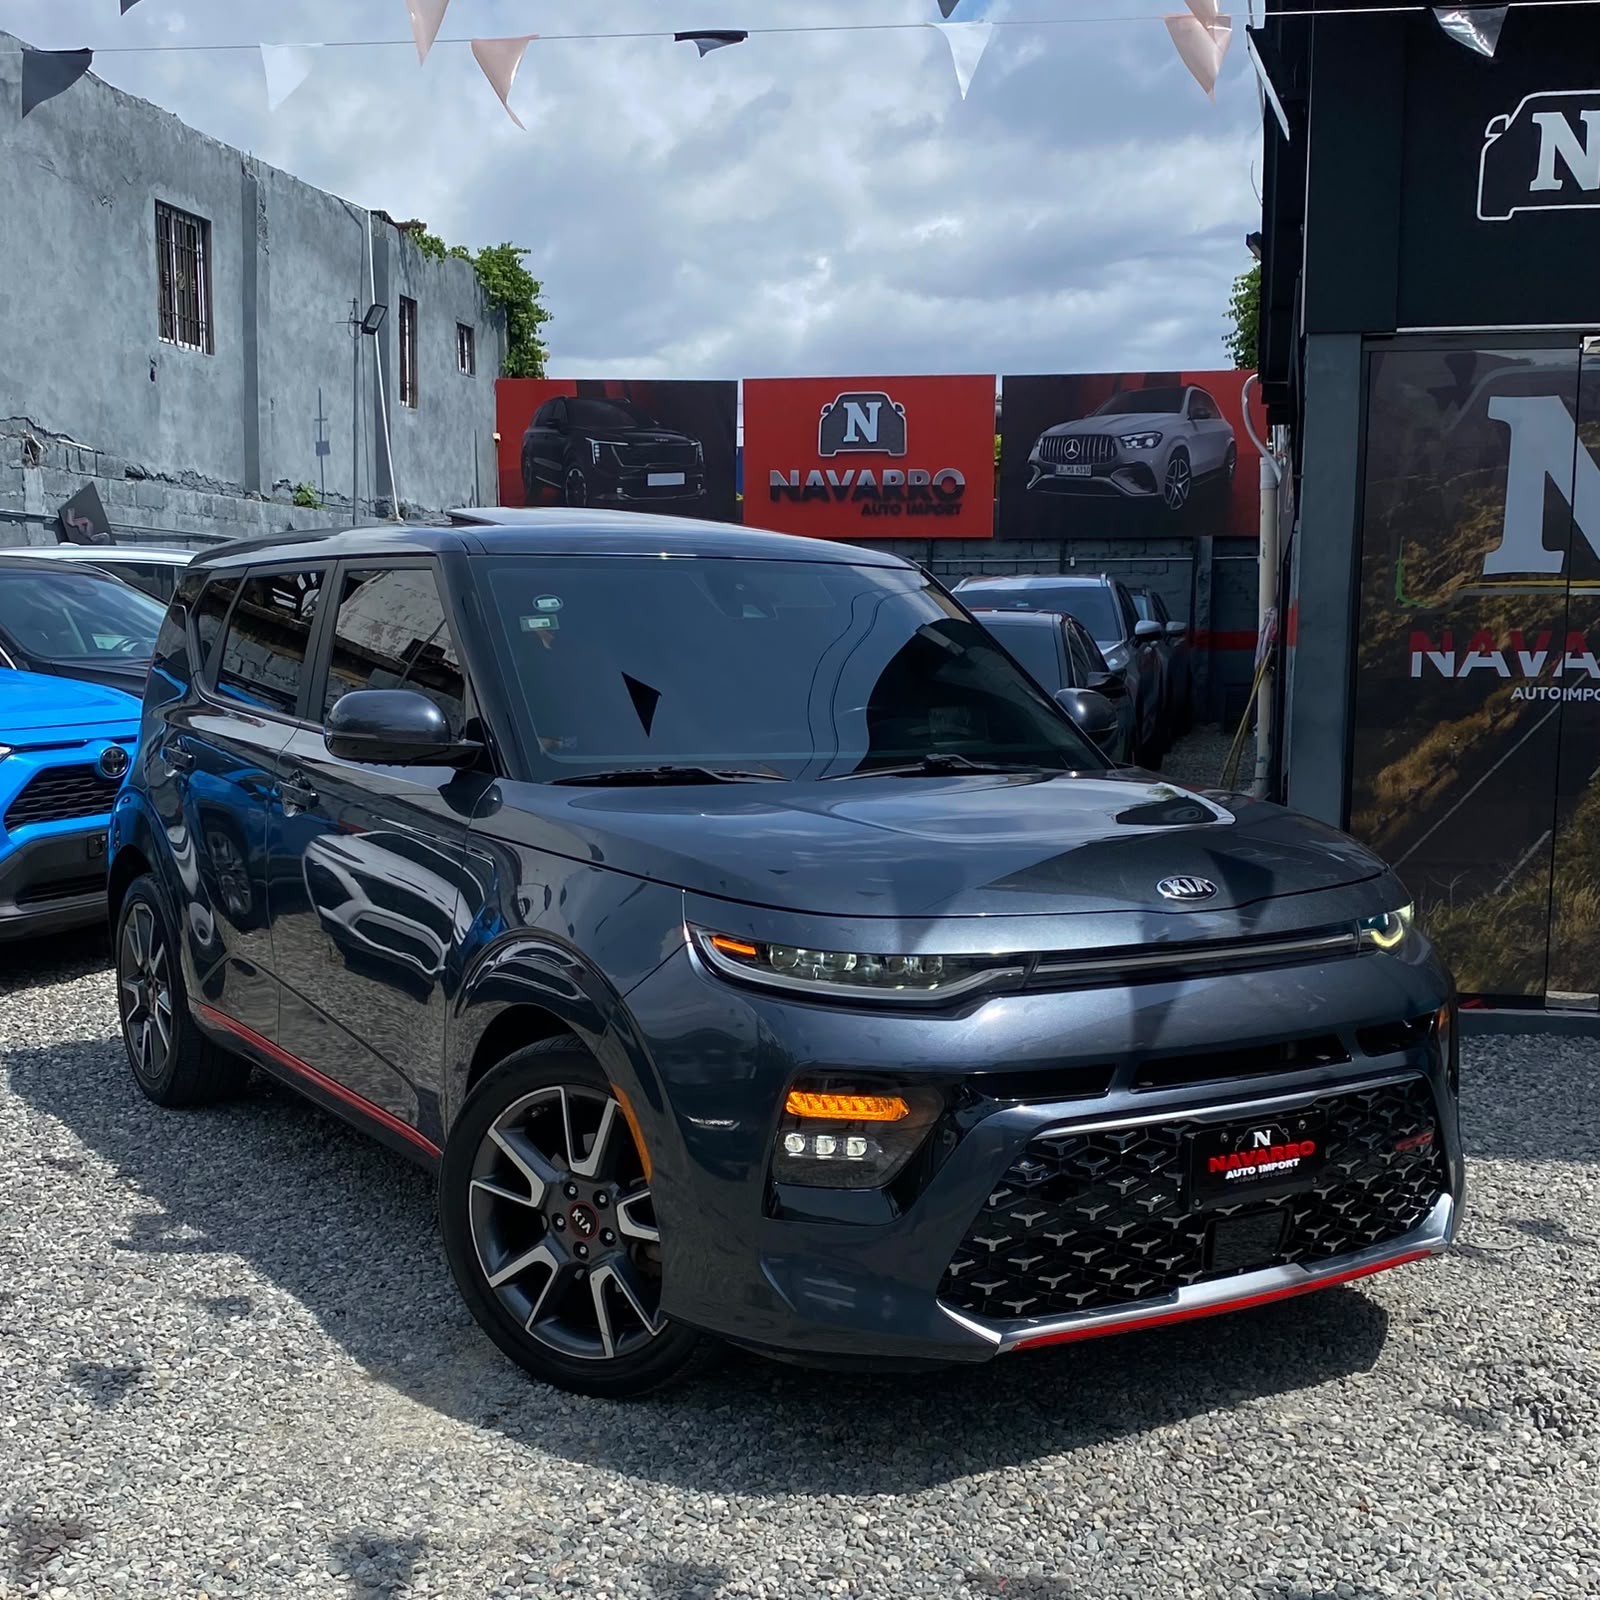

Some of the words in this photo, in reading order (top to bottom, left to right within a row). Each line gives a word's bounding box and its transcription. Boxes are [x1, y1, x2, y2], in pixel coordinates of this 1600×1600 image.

[1529, 109, 1600, 191] N
[843, 401, 882, 443] N
[769, 467, 966, 503] NAVARRO
[1483, 395, 1600, 576] N
[861, 503, 901, 517] AUTO
[906, 503, 963, 517] IMPORT
[1164, 878, 1212, 896] KIA
[1253, 1129, 1272, 1148] N
[1208, 1140, 1316, 1173] NAVARRO
[1225, 1166, 1256, 1180] AUTO
[1258, 1158, 1301, 1174] IMPORT
[571, 1208, 592, 1235] KIA
